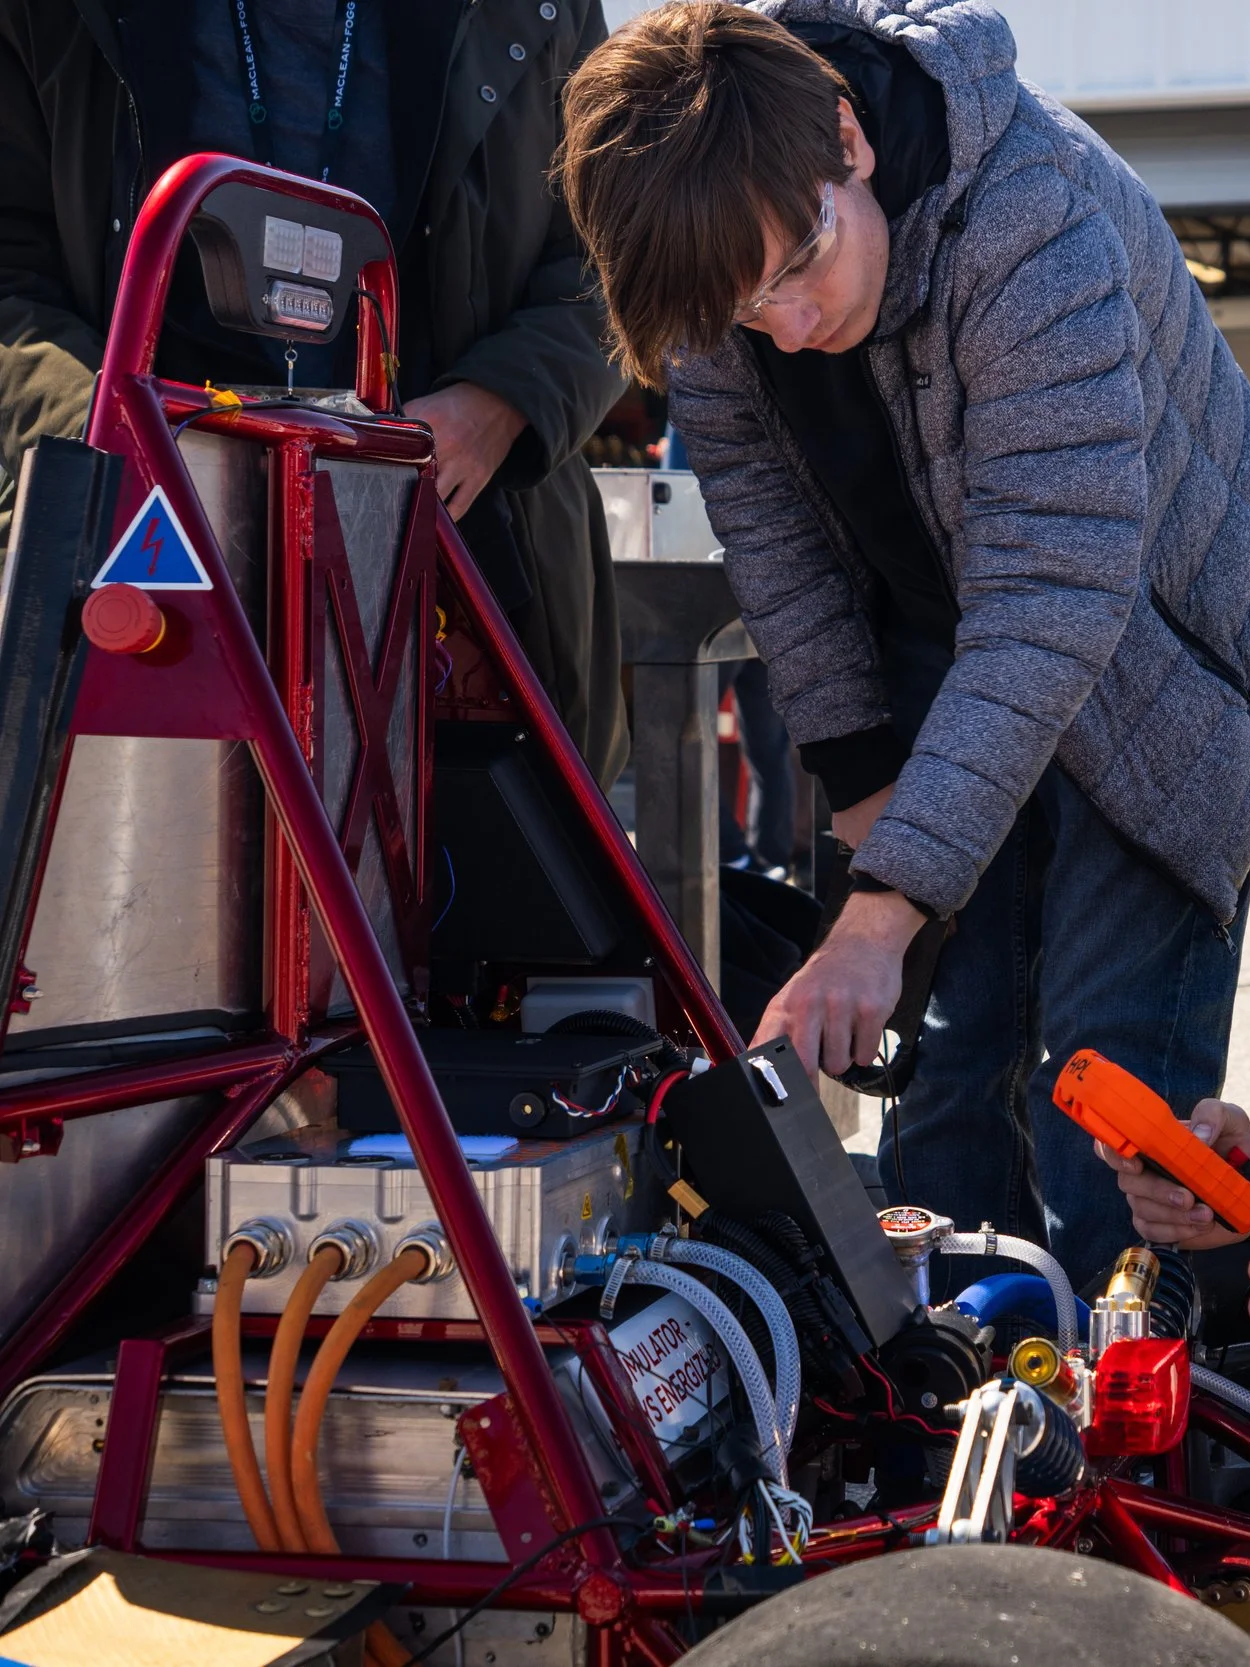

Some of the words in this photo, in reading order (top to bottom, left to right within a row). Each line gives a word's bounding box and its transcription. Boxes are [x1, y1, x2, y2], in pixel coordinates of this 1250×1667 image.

[237, 0, 261, 100] MACLEAN-FOG
[334, 1, 356, 107] MACLEAN-FOGG
[654, 1343, 721, 1414] ENERGIZED
